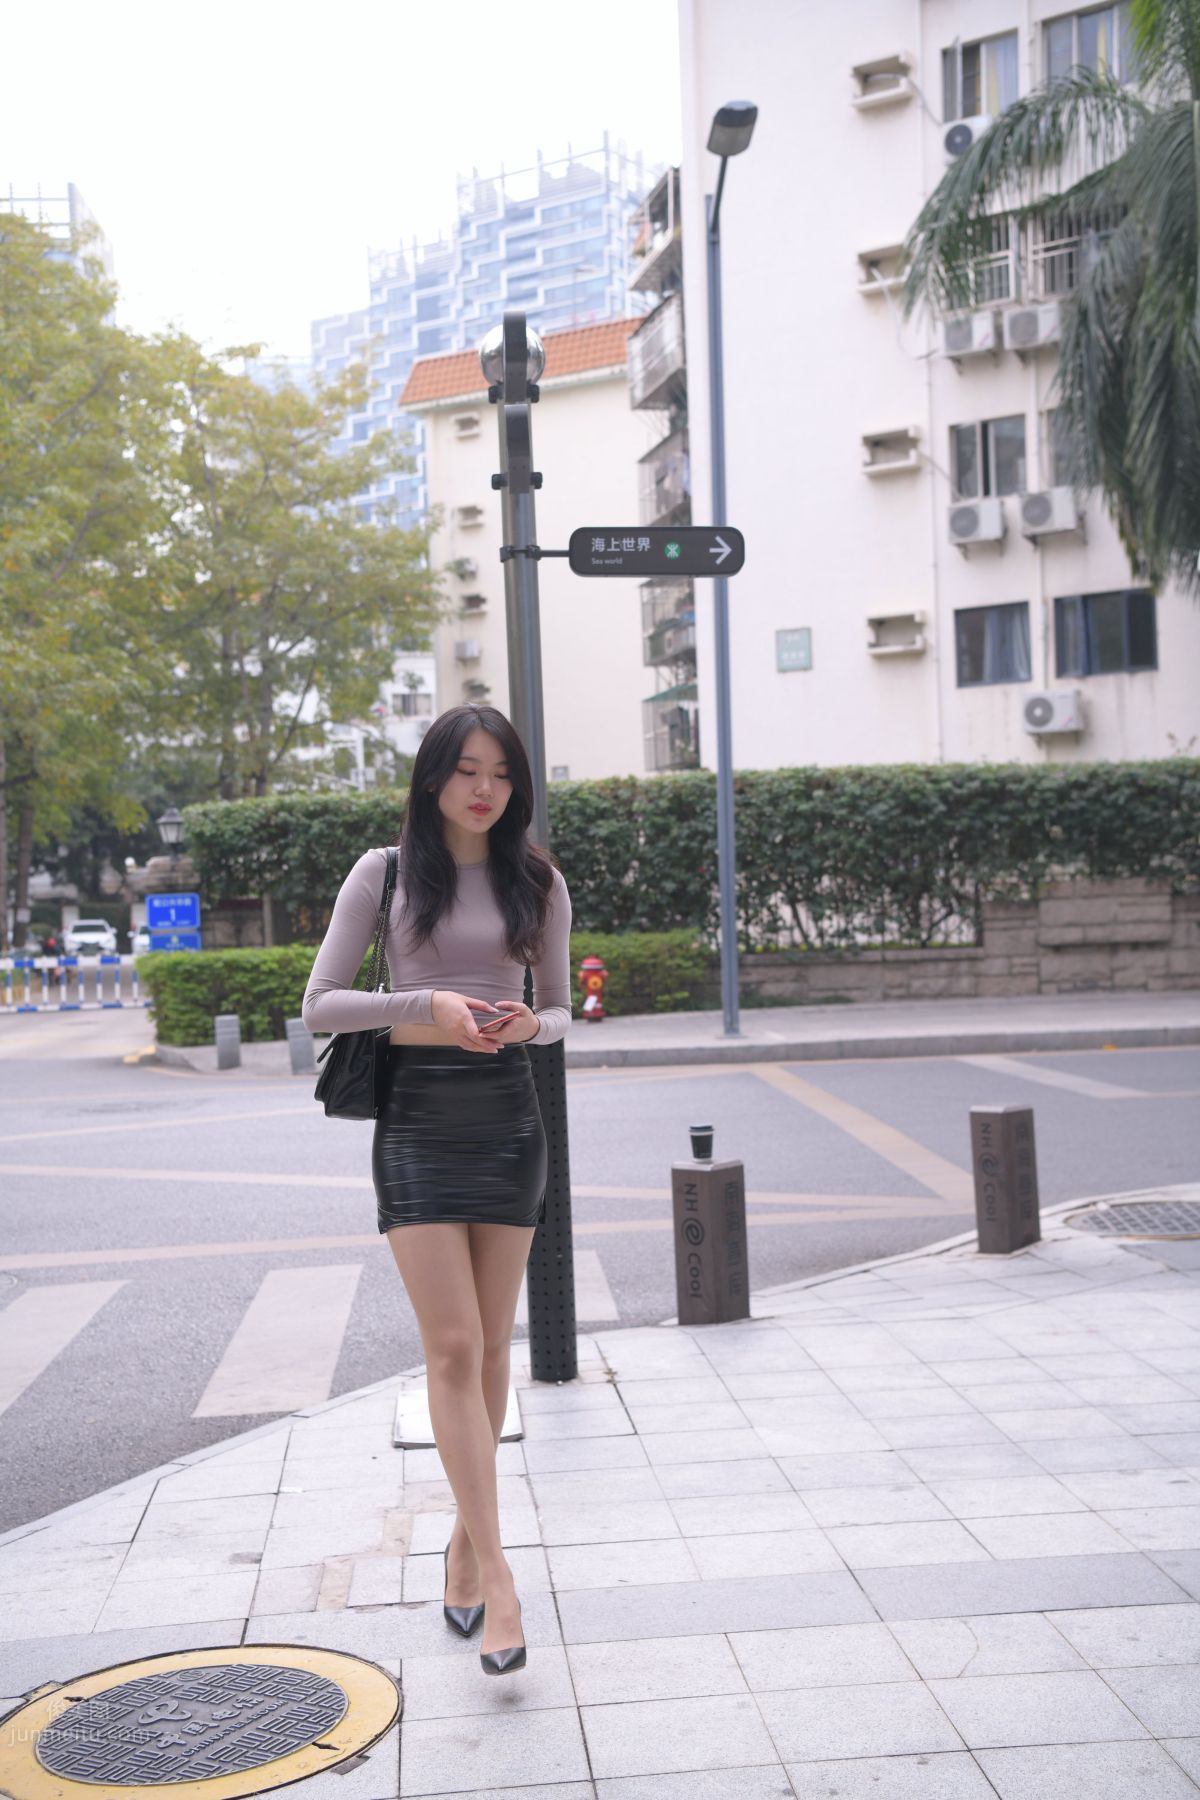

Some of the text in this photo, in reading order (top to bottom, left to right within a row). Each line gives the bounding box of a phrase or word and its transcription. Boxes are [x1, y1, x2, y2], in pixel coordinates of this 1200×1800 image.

[591, 537, 651, 553] 海上世界
[591, 557, 623, 565] Sea world
[156, 1696, 264, 1749] 中国电信
